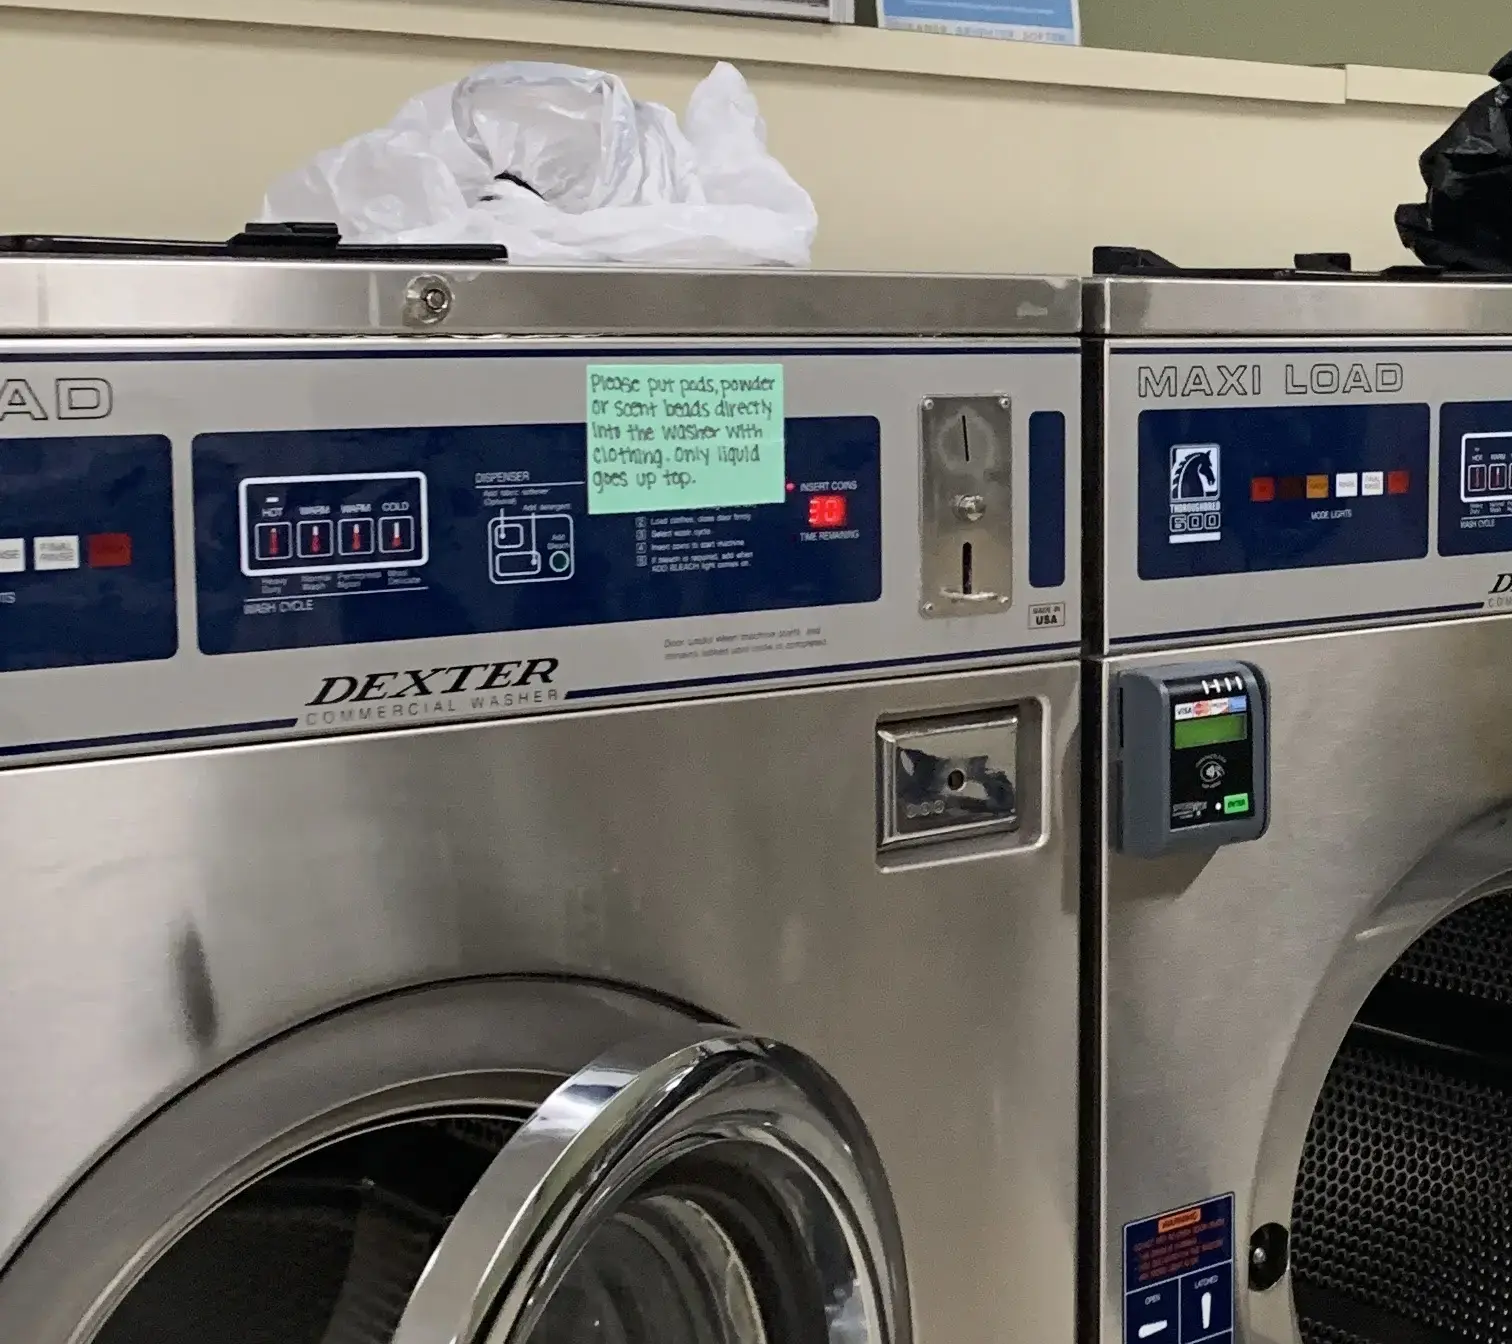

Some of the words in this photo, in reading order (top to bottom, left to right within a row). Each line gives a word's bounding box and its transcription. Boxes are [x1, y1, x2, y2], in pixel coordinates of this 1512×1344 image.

[591, 374, 640, 393] Please
[647, 378, 675, 397] put
[680, 376, 718, 397] pads,
[720, 376, 775, 398] powder
[1138, 365, 1261, 397] MAXI
[1285, 363, 1404, 395] LOAD
[592, 399, 608, 414] or
[614, 401, 658, 417] scent
[663, 399, 710, 417] beads
[714, 399, 772, 421] directly
[627, 424, 655, 441] the
[661, 424, 721, 441] washer
[725, 423, 763, 439] with
[718, 444, 761, 466] liquid
[475, 471, 530, 484] DISPENSER
[592, 470, 629, 494] goes
[636, 472, 656, 490] up
[663, 469, 697, 490] top.
[801, 482, 829, 492] INSERT
[831, 481, 857, 491] COINS
[262, 507, 283, 517] HOT
[381, 501, 410, 512] COLD
[1169, 500, 1221, 514] THOROUGHBRED
[1169, 512, 1221, 533] 600
[1036, 615, 1058, 626] USA
[304, 657, 559, 707] DEXTER
[305, 700, 456, 726] COMMERCIAL
[471, 689, 559, 710] WASHER
[1144, 1293, 1161, 1305] OPEN
